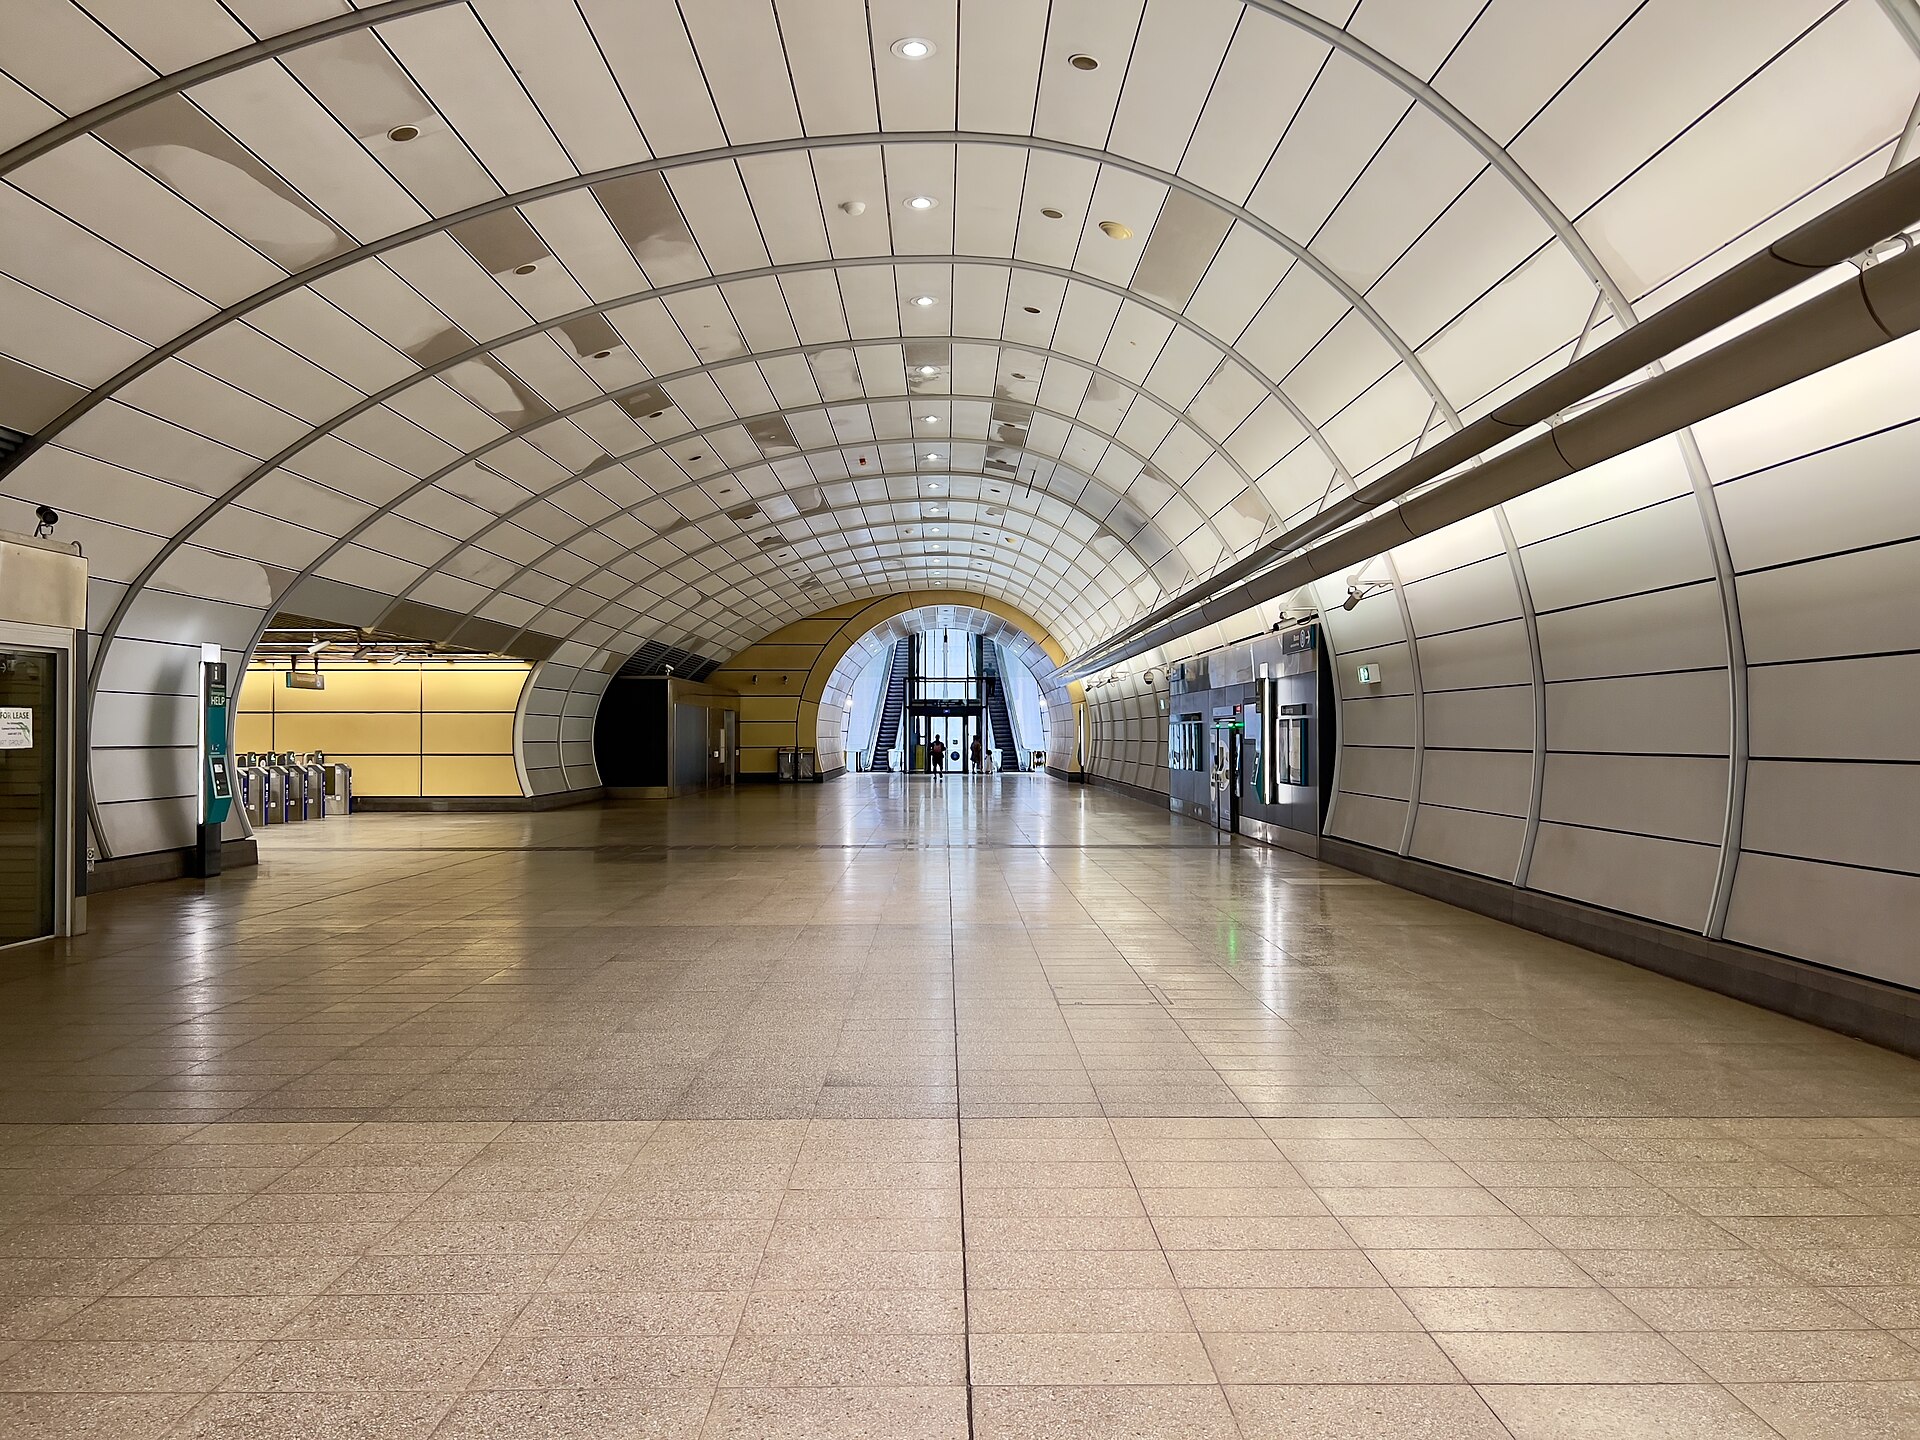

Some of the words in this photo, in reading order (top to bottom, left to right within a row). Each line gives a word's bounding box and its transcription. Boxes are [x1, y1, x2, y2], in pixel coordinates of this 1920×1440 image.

[211, 696, 225, 705] HELP
[0, 711, 12, 720] FOR
[13, 711, 30, 720] LEASE
